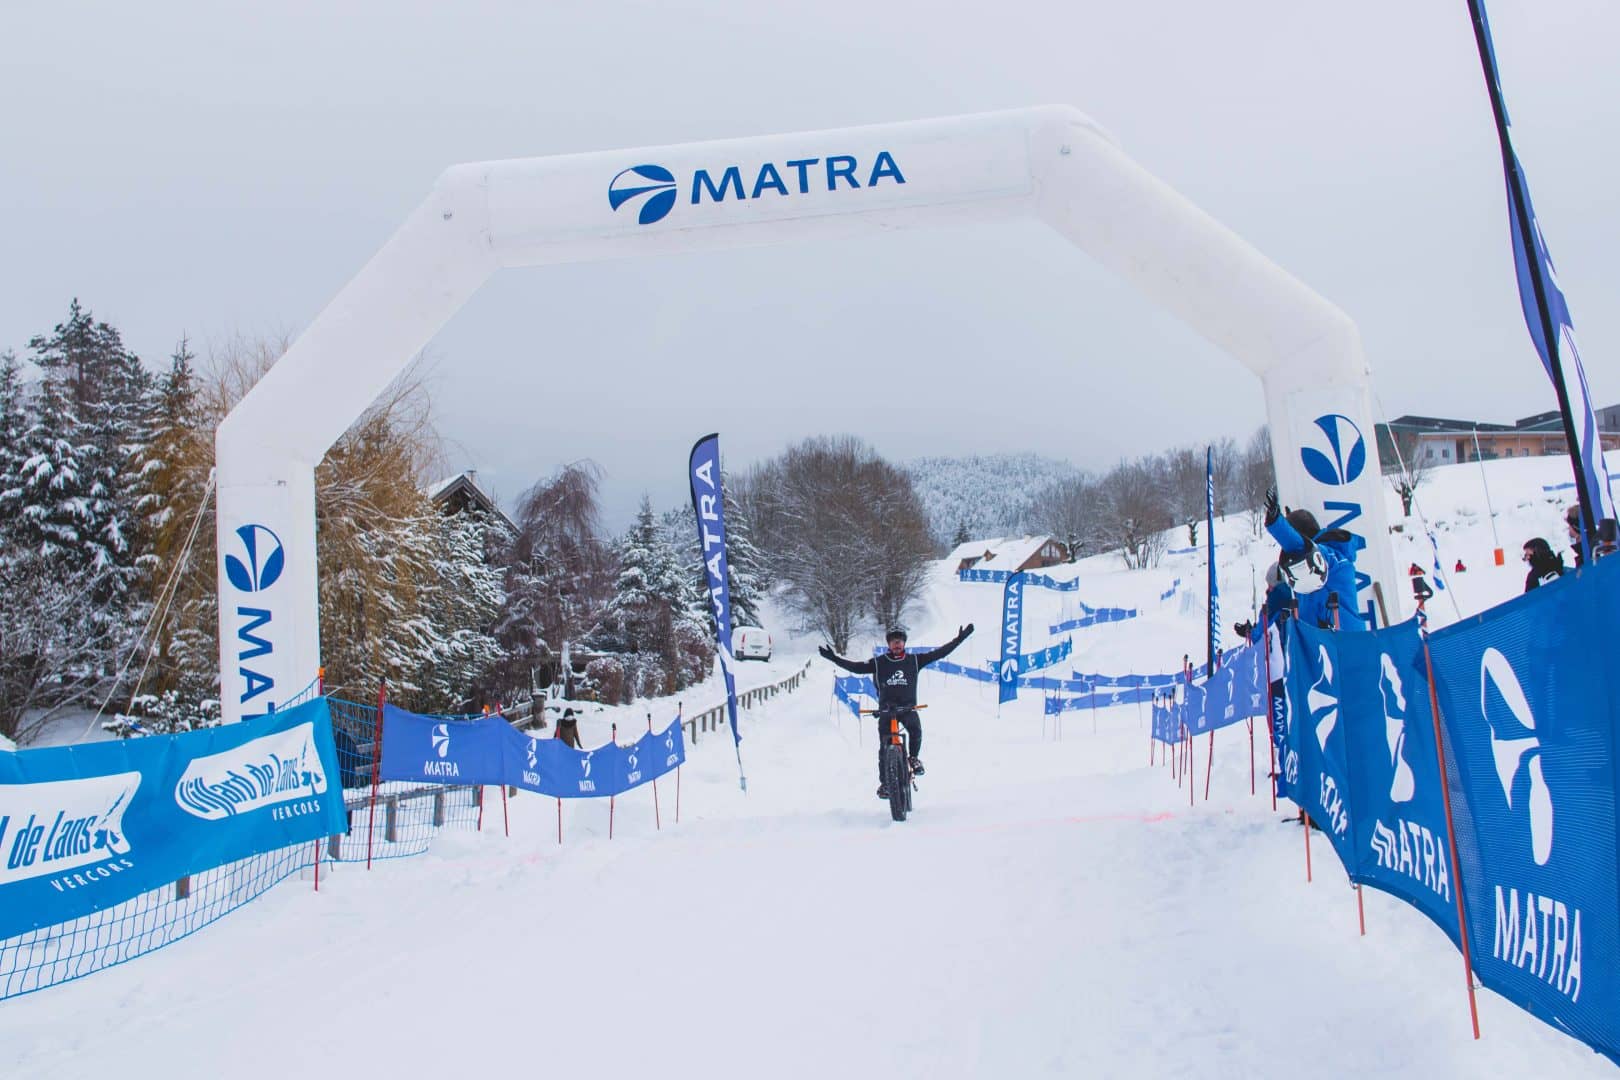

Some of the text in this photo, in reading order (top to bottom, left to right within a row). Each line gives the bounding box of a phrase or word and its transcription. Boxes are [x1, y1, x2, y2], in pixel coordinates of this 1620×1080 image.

[691, 150, 906, 205] MATRA
[1006, 581, 1019, 655] MATRA
[424, 760, 460, 777] MATRA
[7, 813, 46, 870] de
[42, 809, 98, 862] Lans
[272, 800, 321, 821] VERCORS
[50, 858, 134, 892] VERCORS
[1370, 818, 1450, 903] MATRA
[1493, 885, 1581, 1003] MATRA
